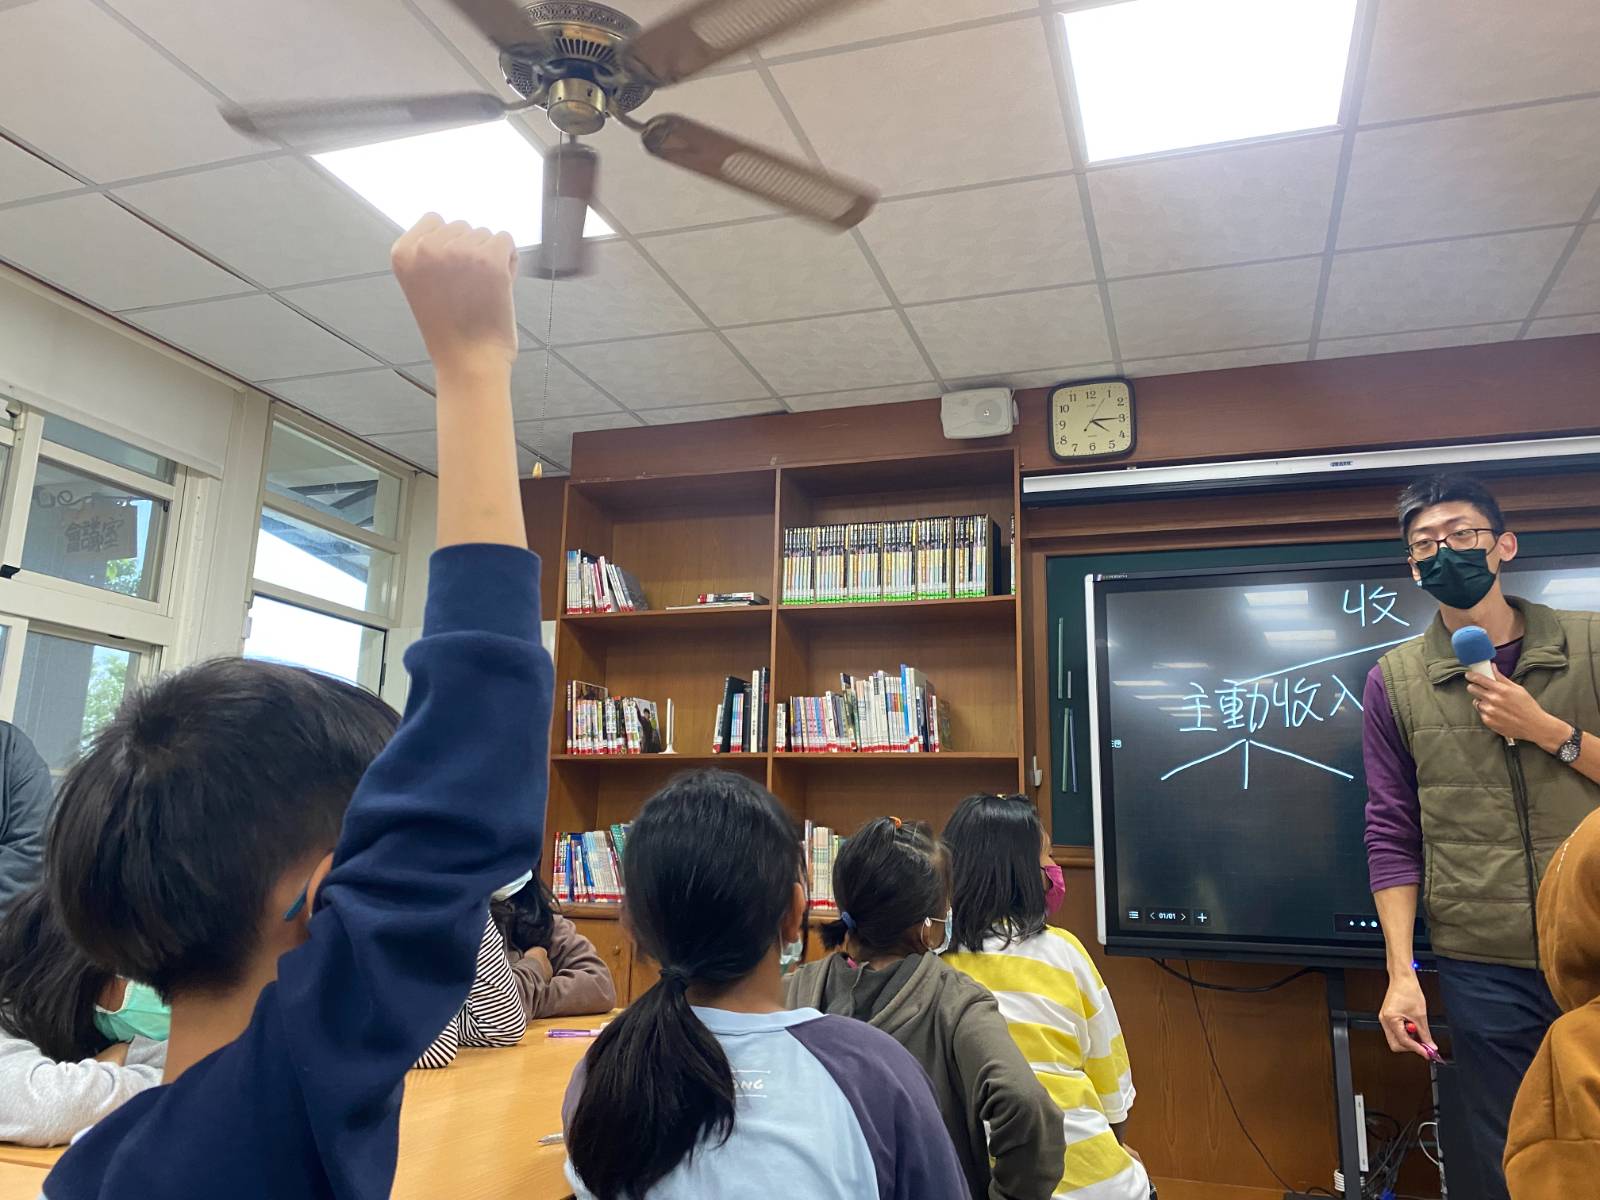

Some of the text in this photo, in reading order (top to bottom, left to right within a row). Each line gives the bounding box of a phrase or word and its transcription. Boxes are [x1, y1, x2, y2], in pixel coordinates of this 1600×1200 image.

[1069, 393, 1077, 402] 11
[1086, 390, 1097, 400] 12
[1117, 397, 1124, 406] 2
[1059, 404, 1070, 413] 10
[1118, 413, 1125, 422] 3
[1059, 420, 1066, 430] 9
[1119, 430, 1125, 439] 4
[1060, 435, 1067, 445] 8
[1109, 440, 1115, 449] 5
[1072, 443, 1078, 452] 7
[1089, 442, 1096, 451] 6
[1342, 583, 1411, 627] 收
[1179, 674, 1365, 733] 主動收入
[1158, 912, 1176, 920] 01/01
